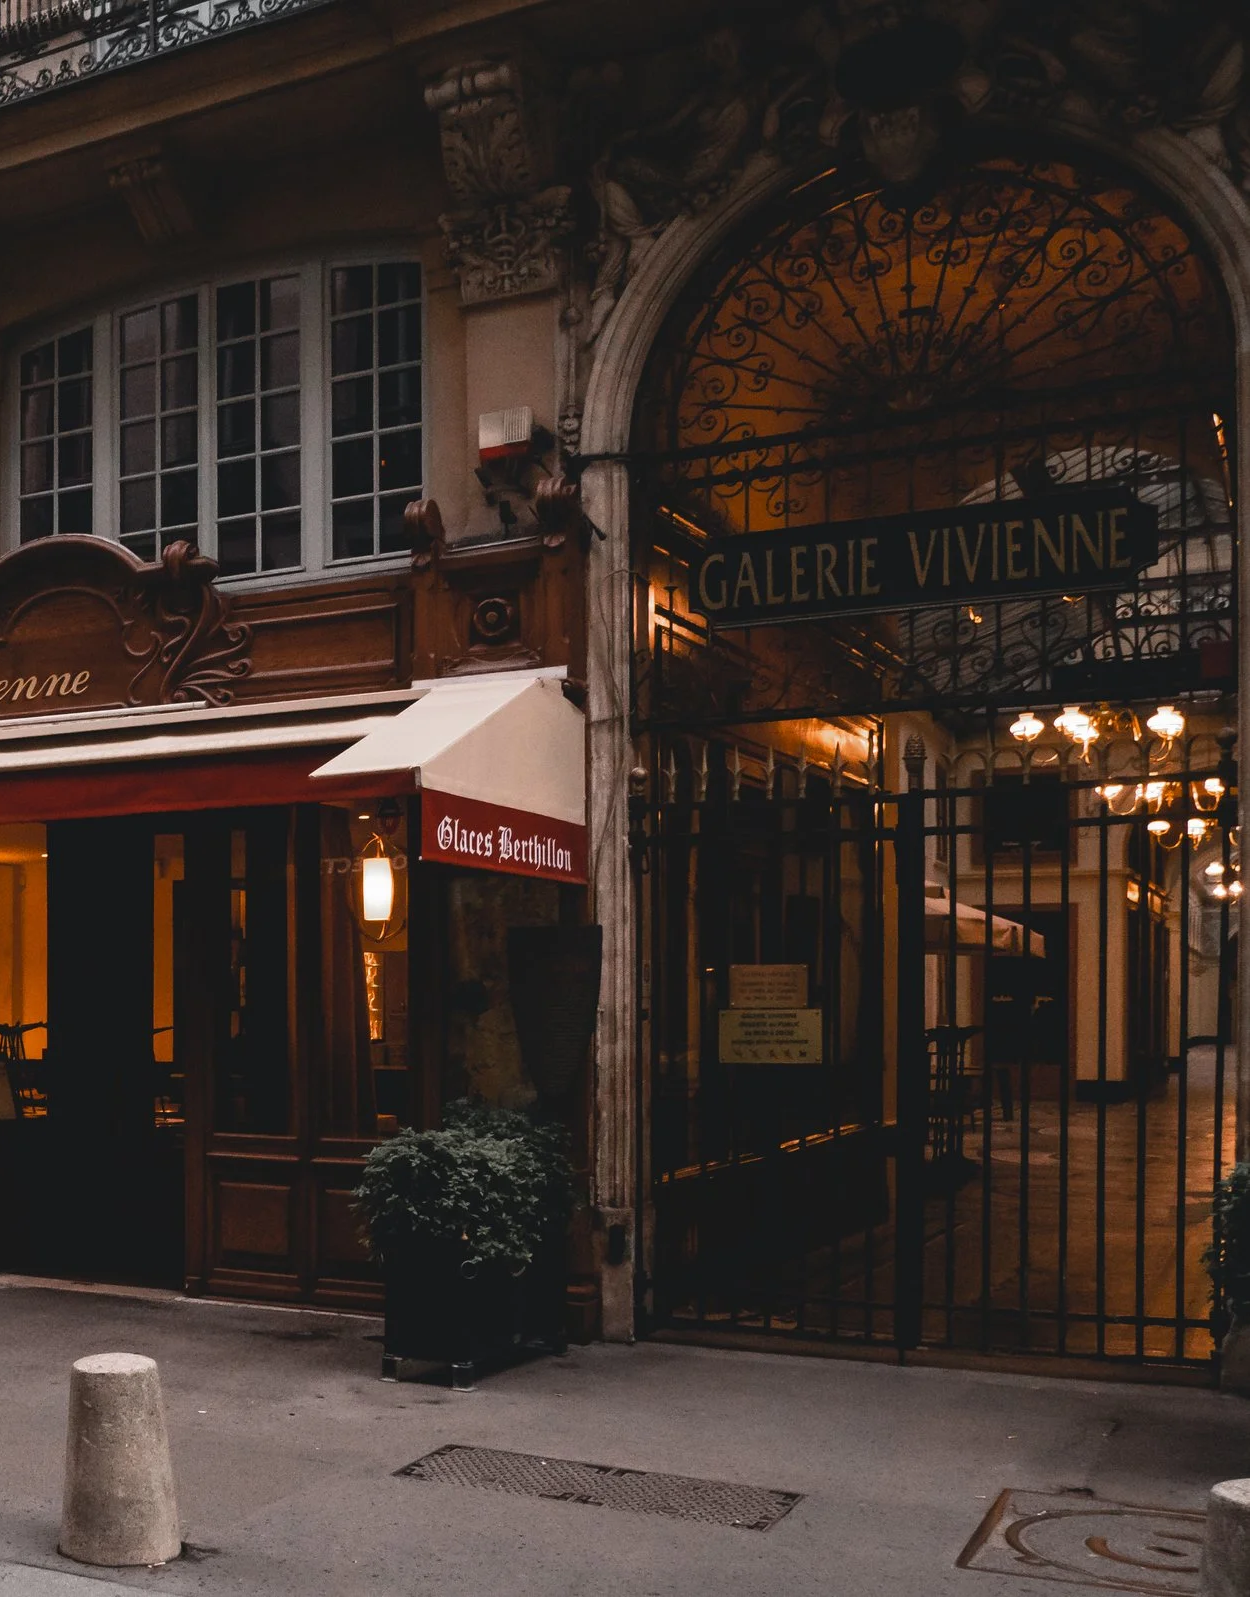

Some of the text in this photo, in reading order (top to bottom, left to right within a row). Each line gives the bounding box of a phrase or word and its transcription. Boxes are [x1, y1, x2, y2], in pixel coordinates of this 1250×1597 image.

[698, 507, 1132, 611] GALERIE VIVIENNE
[437, 815, 572, 873] Glaces Berthillon
